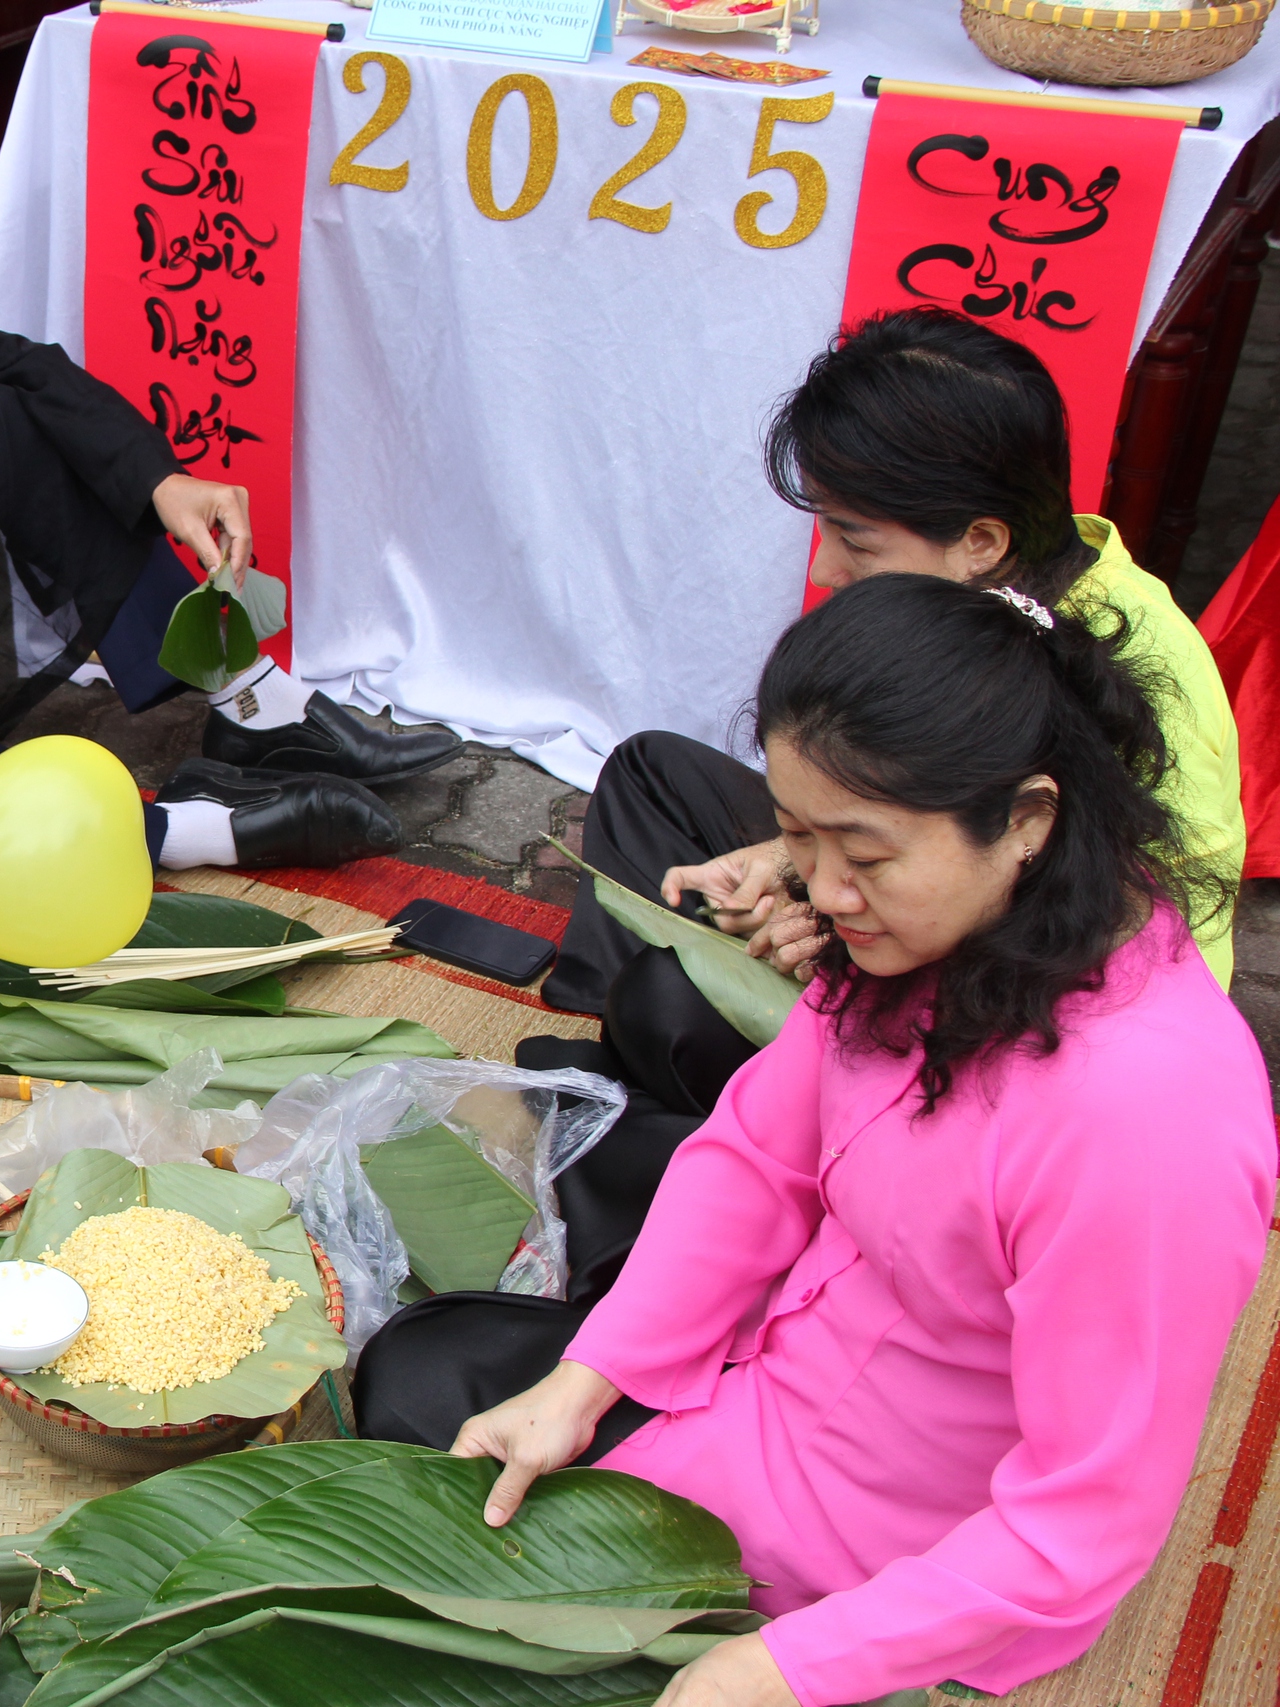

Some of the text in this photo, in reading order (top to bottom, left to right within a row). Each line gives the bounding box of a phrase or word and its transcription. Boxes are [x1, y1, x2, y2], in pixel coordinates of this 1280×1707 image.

[420, 15, 460, 29] THÀNH
[462, 20, 487, 32] PHỐ
[489, 22, 504, 34] ĐÀ
[453, 5, 475, 16] CHI
[477, 7, 503, 20] CỤC
[505, 8, 540, 23] NÔNG
[542, 14, 589, 29] NGHIỆP
[329, 51, 835, 249] 2025
[907, 134, 1121, 245] Cung
[134, 203, 278, 292] Nghĩa
[897, 243, 1104, 333] Chúc
[144, 291, 257, 388] Nặng
[235, 687, 259, 720] POLO
